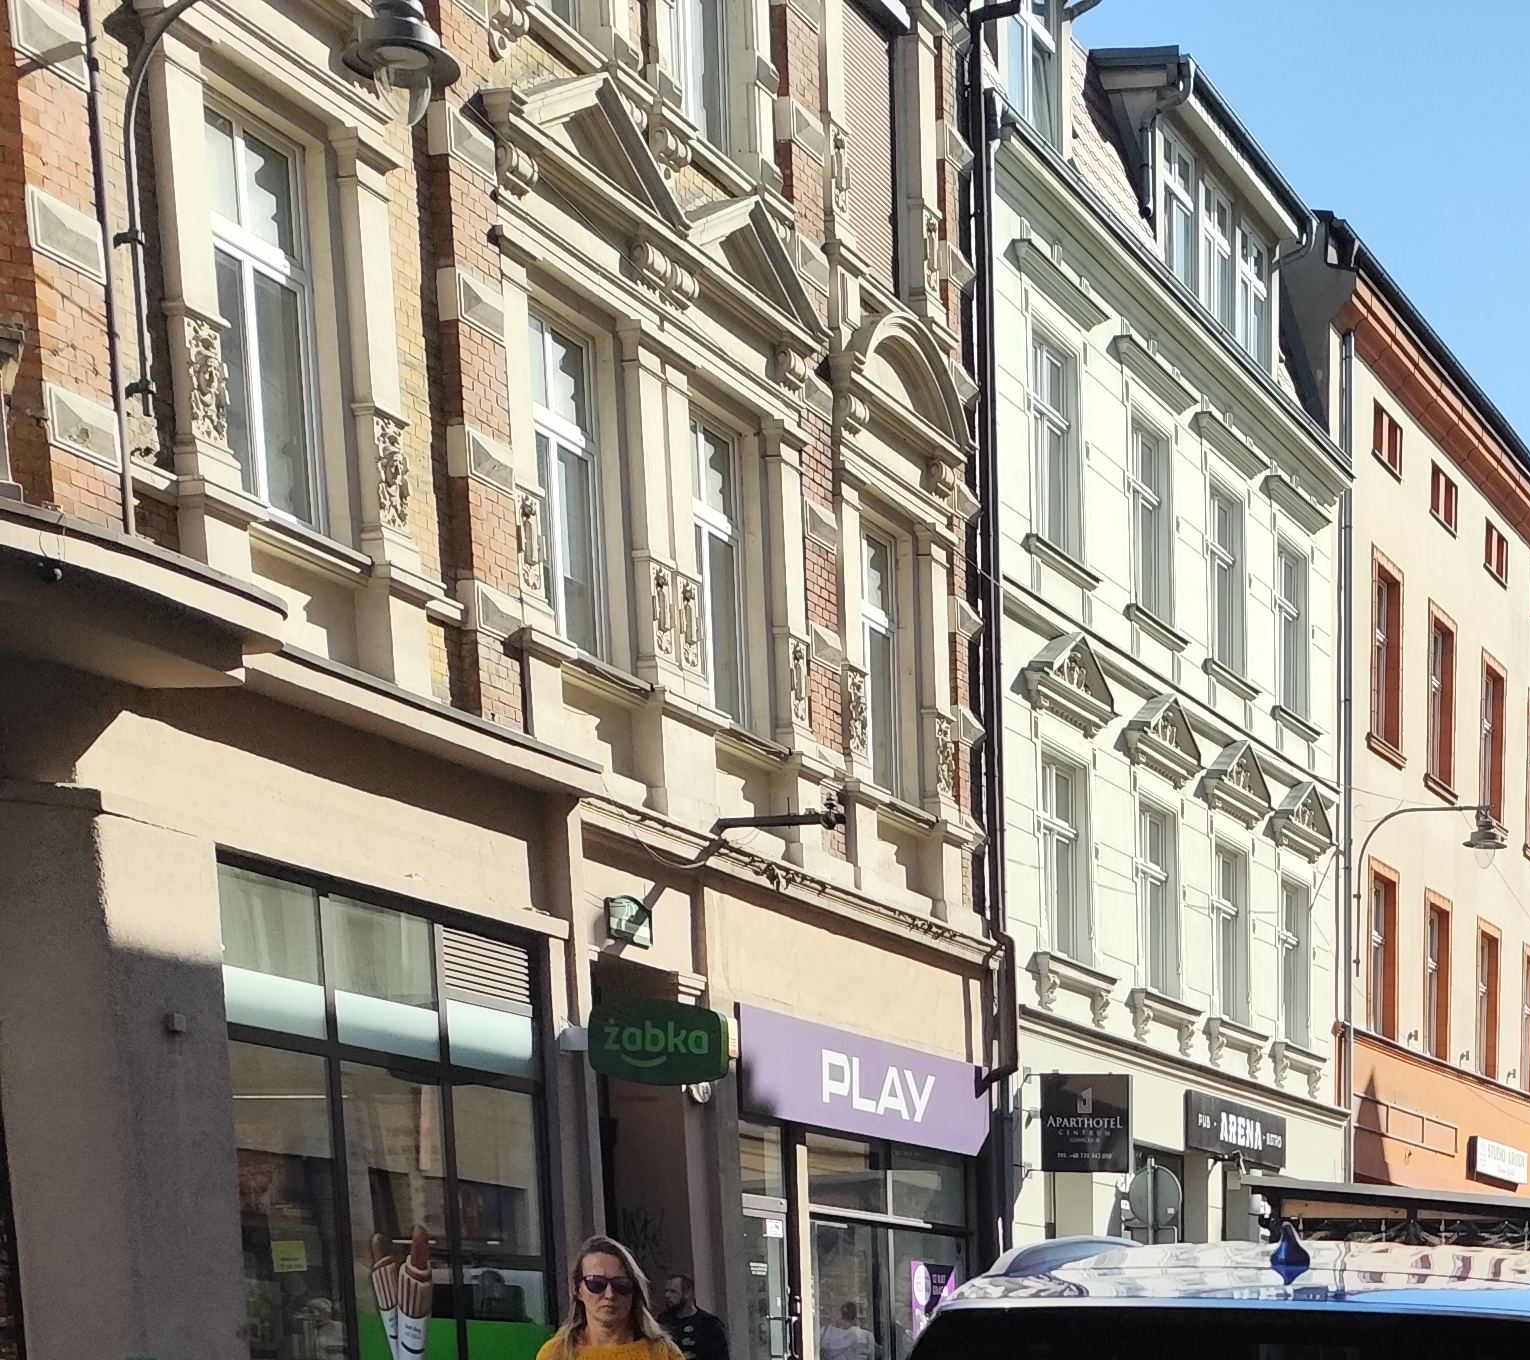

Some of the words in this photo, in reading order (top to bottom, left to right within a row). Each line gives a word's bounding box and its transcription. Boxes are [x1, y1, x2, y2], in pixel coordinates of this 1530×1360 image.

[603, 1017, 709, 1055] żabka
[821, 1048, 936, 1122] PLAY
[1046, 1115, 1124, 1129] APARTHOTEL
[1198, 1113, 1211, 1129] PUB
[1220, 1111, 1263, 1150] ARENA
